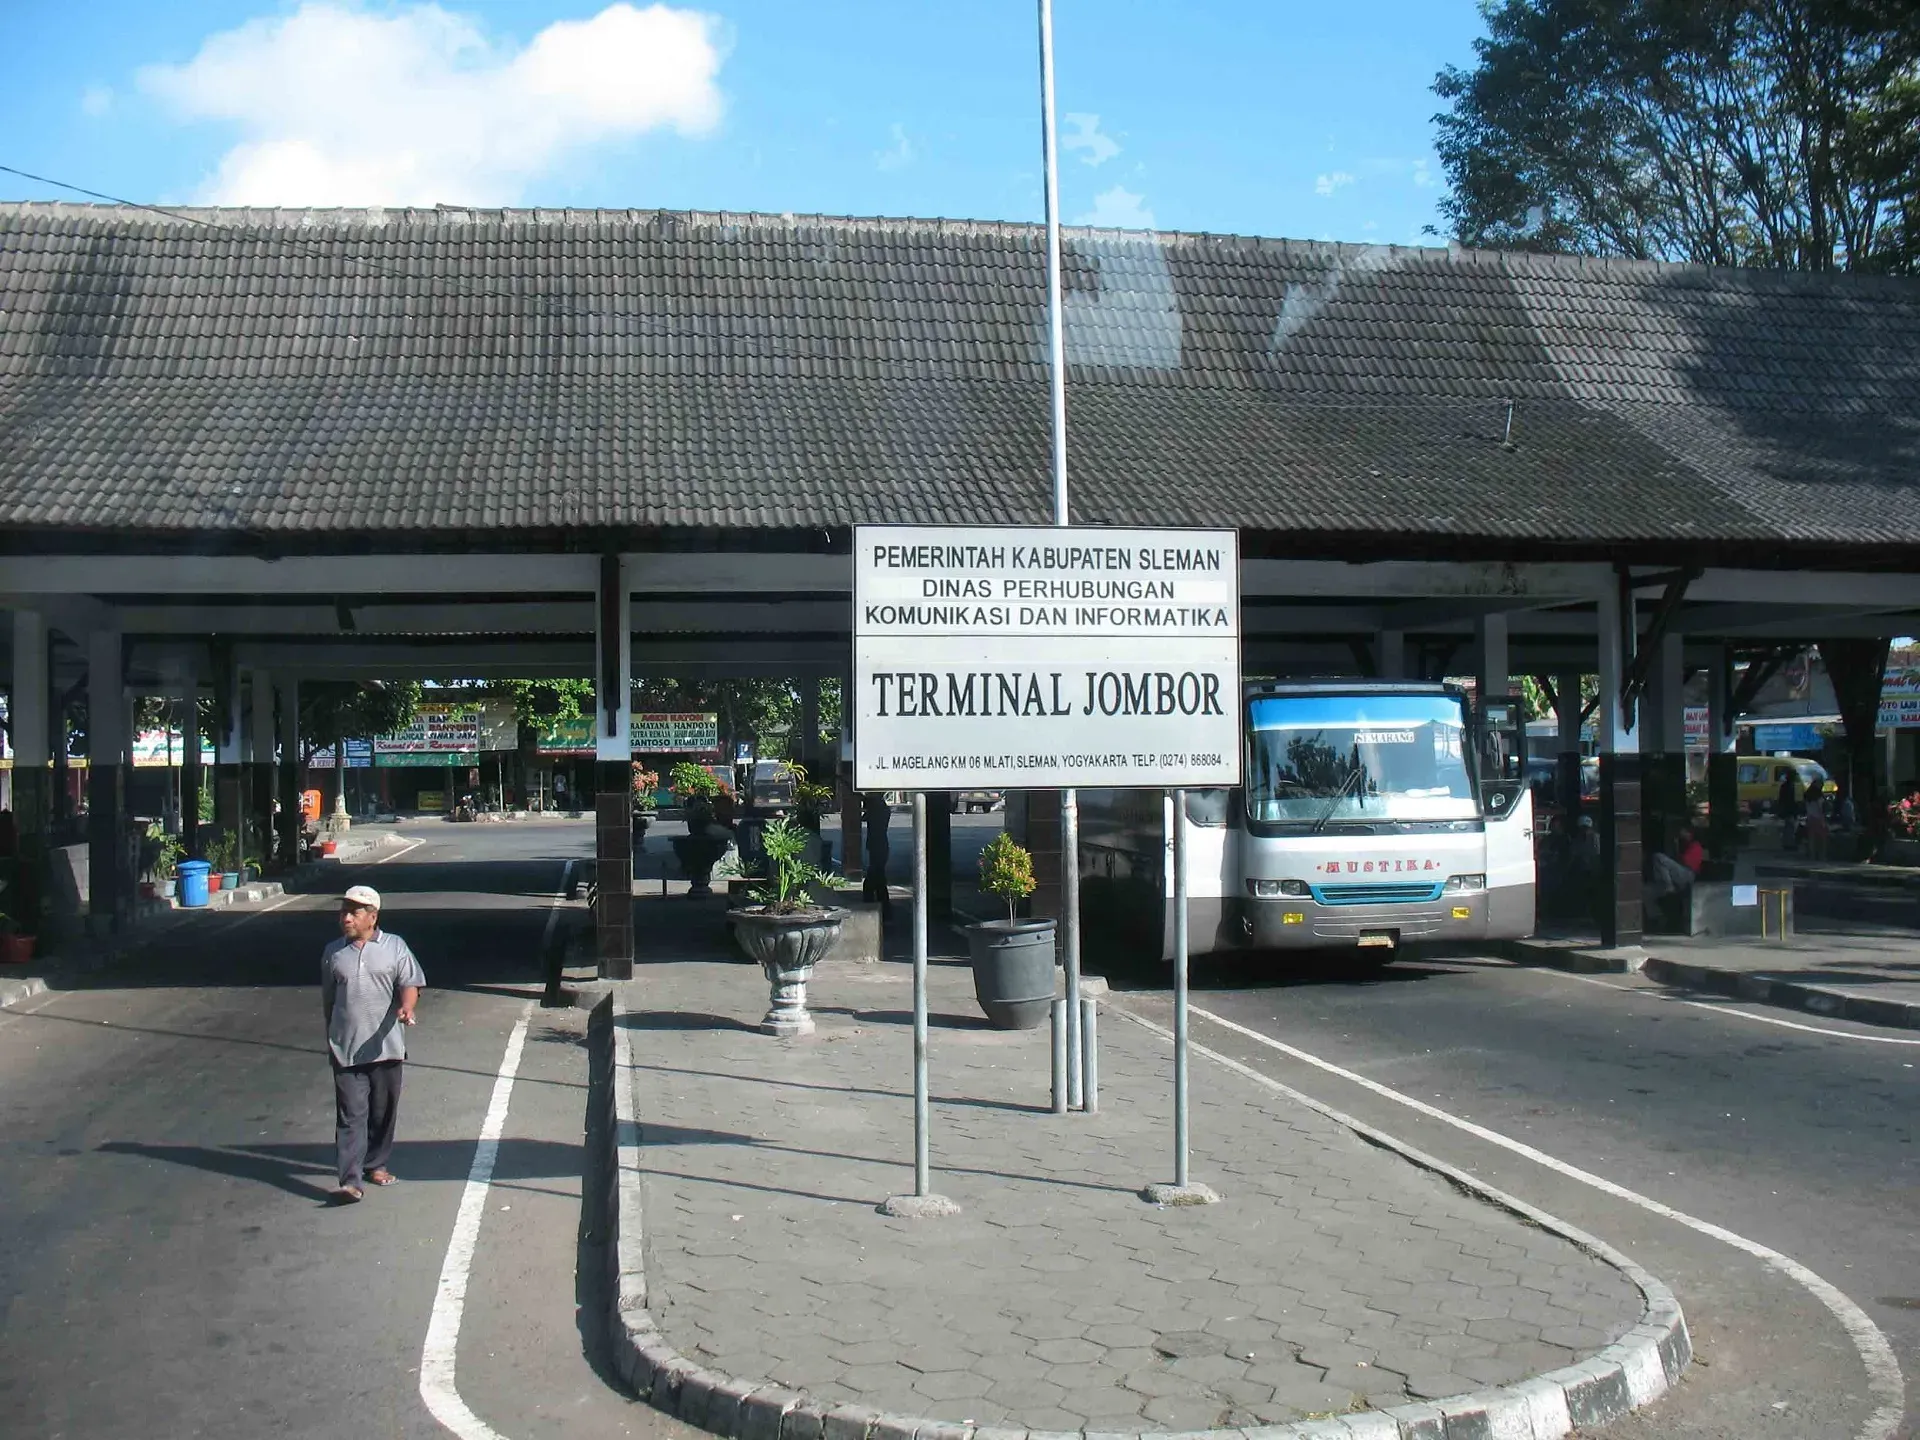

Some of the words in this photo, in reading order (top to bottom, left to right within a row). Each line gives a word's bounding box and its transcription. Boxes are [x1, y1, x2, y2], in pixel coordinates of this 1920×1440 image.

[874, 545, 1005, 569] PEMERINTAH
[1012, 546, 1131, 570] KABUPATEN
[1139, 548, 1220, 571] SLEMAN
[923, 579, 992, 598] DINAS
[1004, 579, 1174, 599] PERHUBUNGAN
[865, 605, 1010, 625] KOMUNIKASI
[1019, 607, 1067, 625] DAN
[1075, 606, 1229, 627] INFORMATIKA
[872, 672, 1072, 717] TERMINAL
[1083, 671, 1224, 716] JOMBOR
[674, 722, 716, 730] HANDOYO
[630, 739, 671, 747] SANTOSO
[876, 757, 889, 770] JL.
[892, 756, 949, 769] MAGELANG
[951, 756, 966, 769] KM
[969, 755, 981, 769] 06
[1062, 754, 1128, 768] YOGYAKARTA
[1132, 754, 1158, 767] TELP.
[1159, 753, 1187, 769] (0274)
[1190, 753, 1222, 766] 868084
[1325, 859, 1434, 874] MUSTIKA
